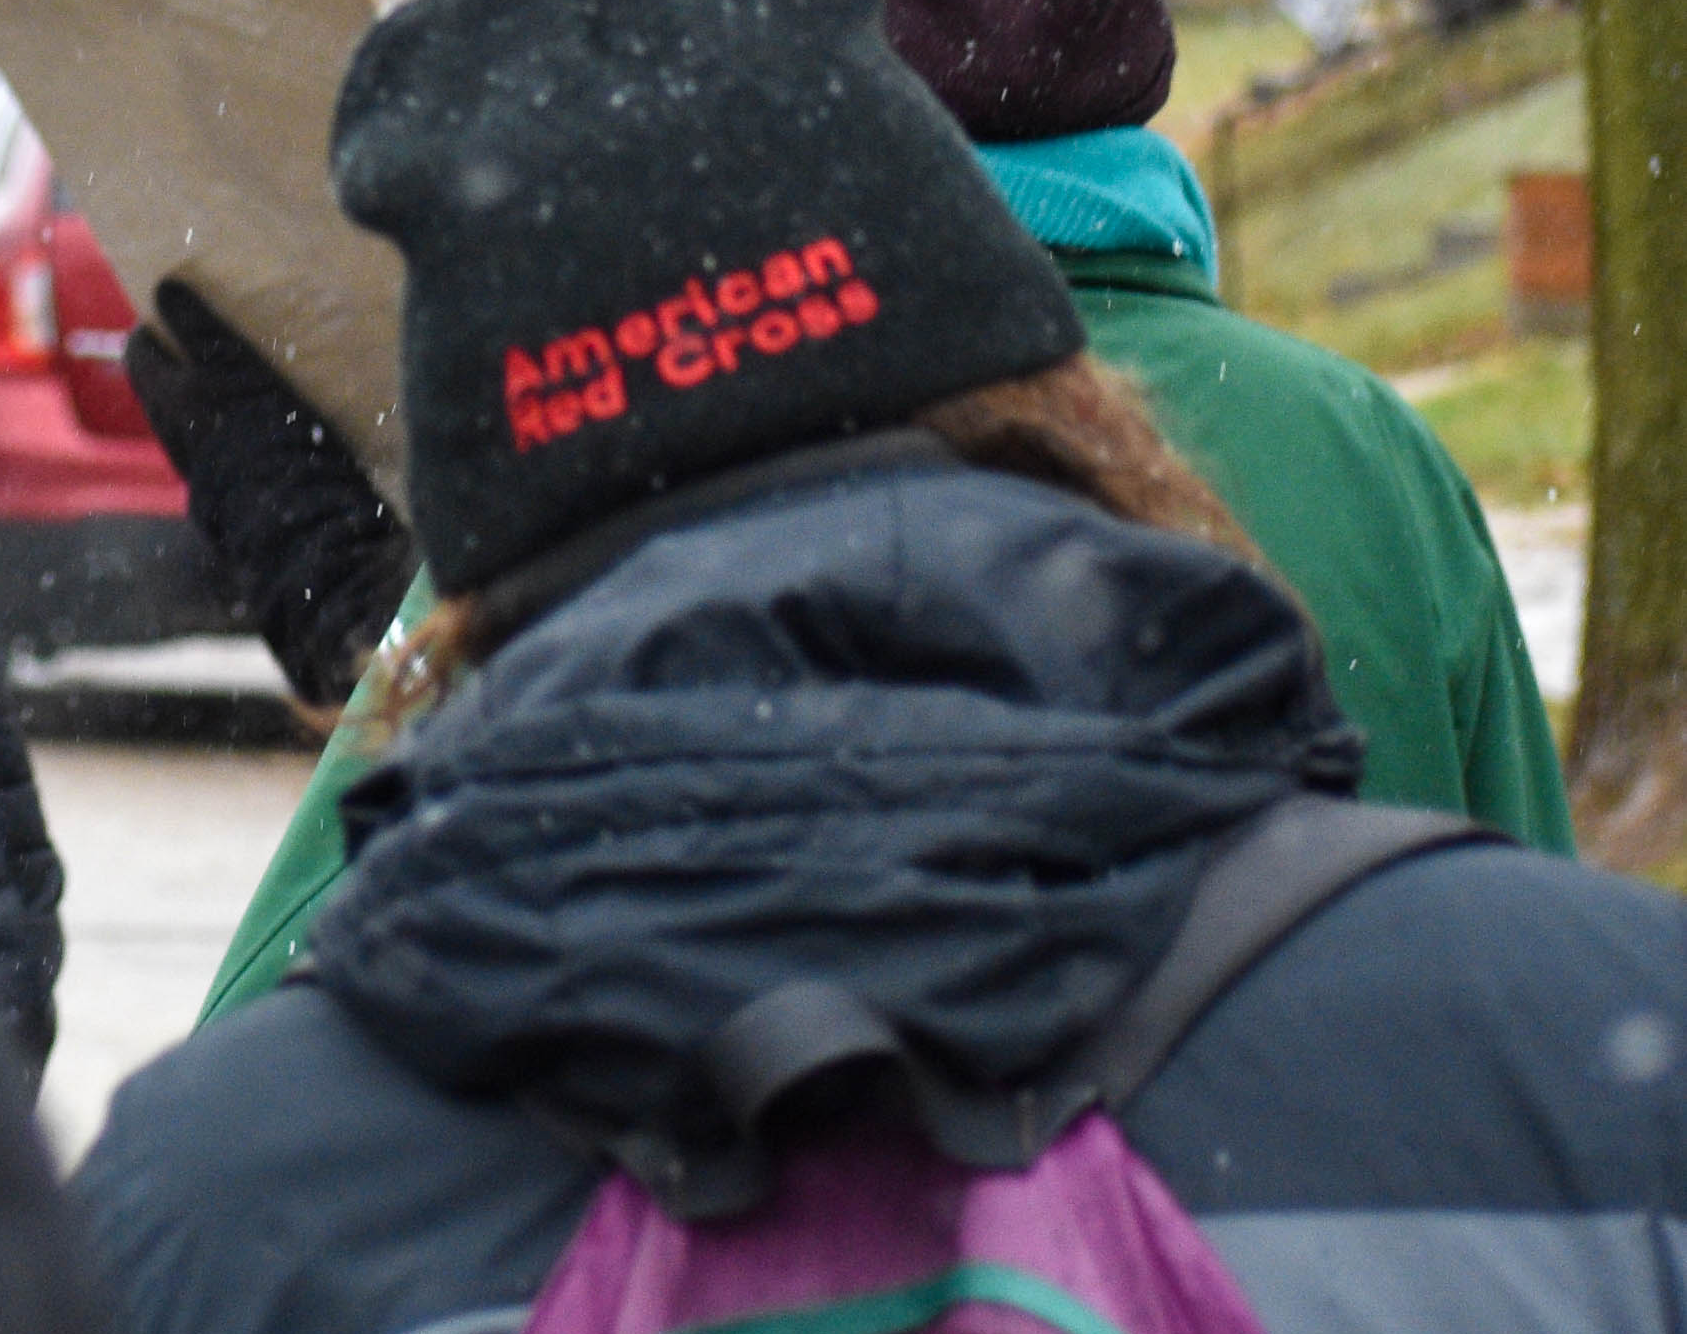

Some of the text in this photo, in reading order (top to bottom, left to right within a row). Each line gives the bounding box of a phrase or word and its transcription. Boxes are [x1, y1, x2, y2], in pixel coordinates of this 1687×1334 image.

[504, 235, 854, 395] American
[508, 277, 881, 455] Red Cross
